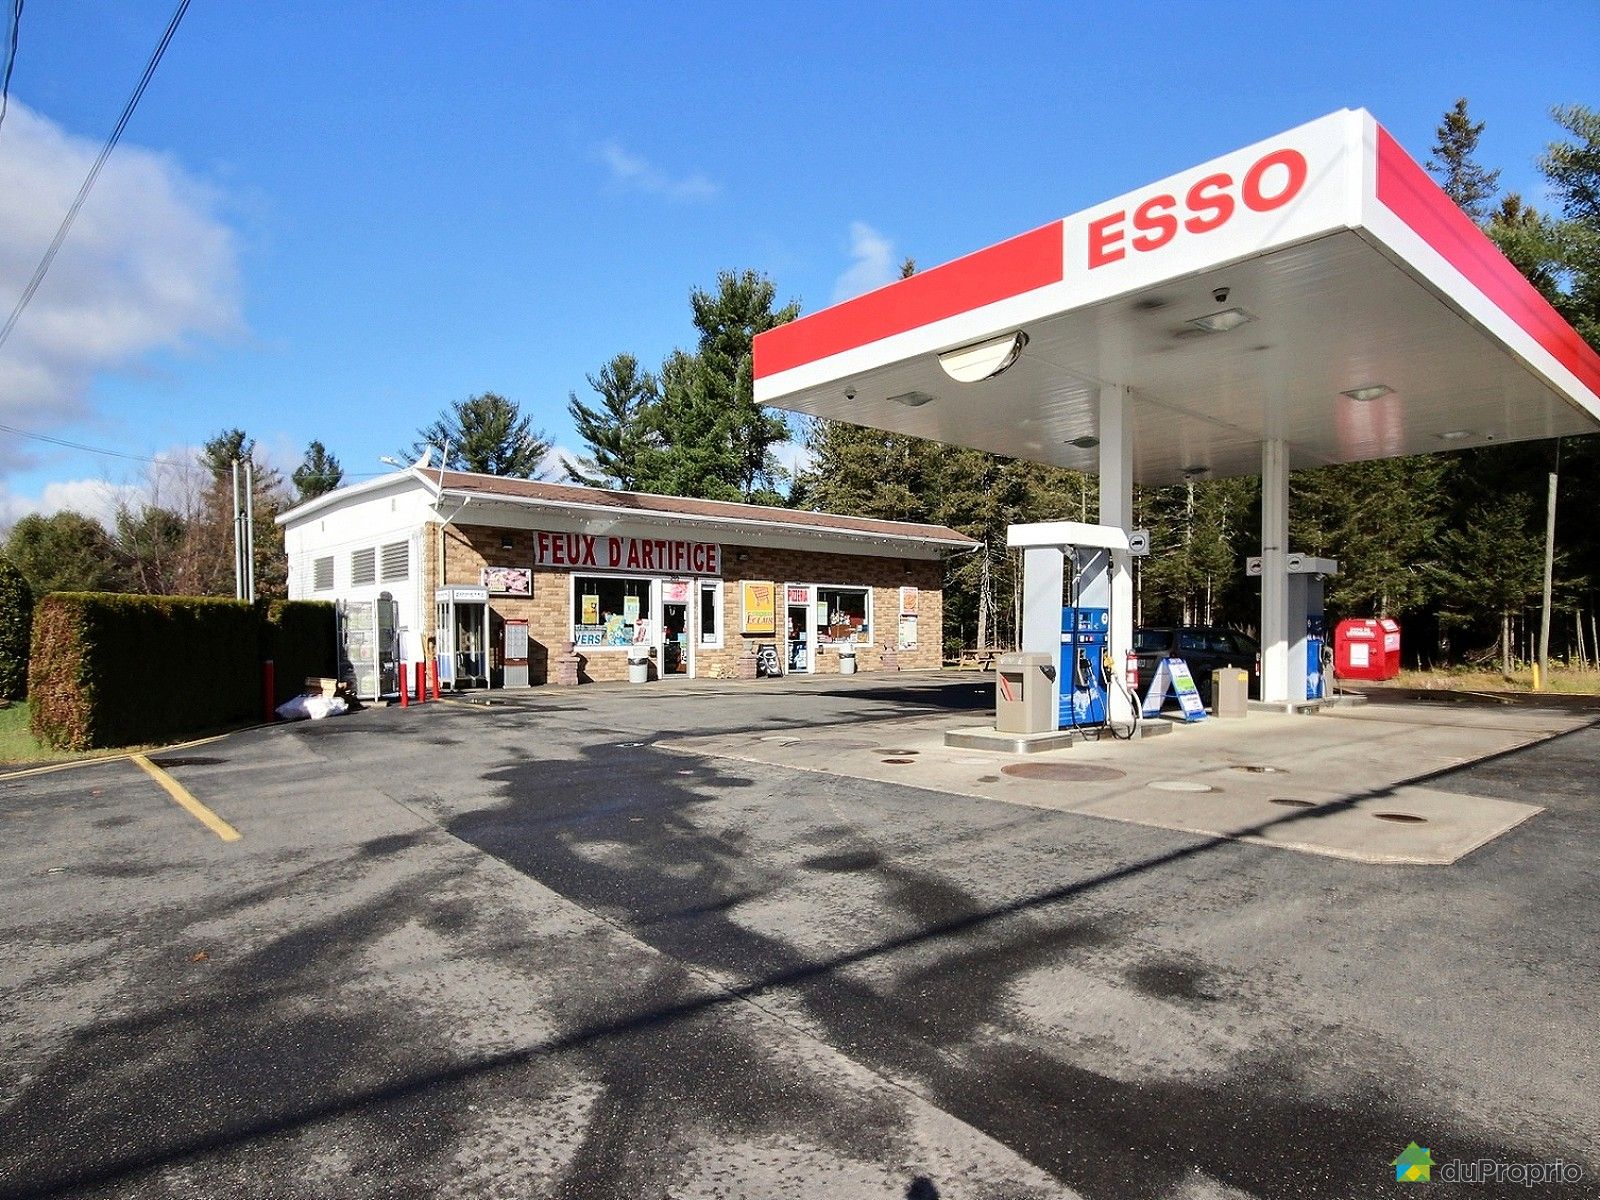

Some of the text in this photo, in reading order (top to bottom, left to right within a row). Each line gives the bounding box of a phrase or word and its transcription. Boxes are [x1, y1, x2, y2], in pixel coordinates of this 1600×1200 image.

[1088, 148, 1308, 270] ESSO
[537, 532, 716, 573] FEUX D'ARTIFICE
[787, 589, 809, 603] PIZZERIA
[575, 634, 601, 645] VERS
